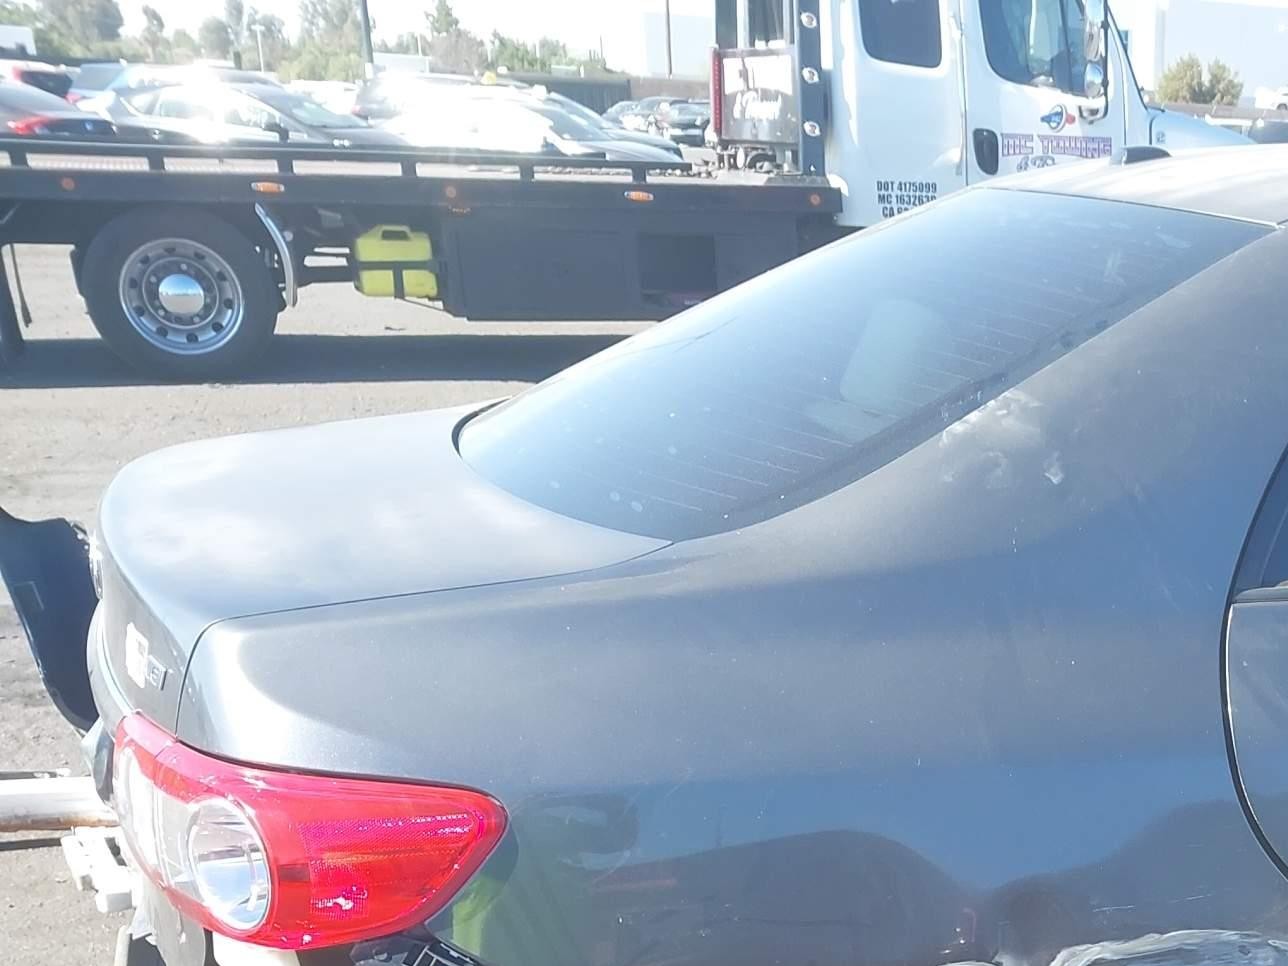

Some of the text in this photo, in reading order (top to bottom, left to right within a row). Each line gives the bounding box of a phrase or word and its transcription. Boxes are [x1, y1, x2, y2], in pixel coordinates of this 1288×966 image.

[1000, 133, 1112, 159] MC TOWING
[876, 180, 937, 193] DOT 4175099
[877, 193, 893, 205] MC
[882, 206, 895, 218] CA
